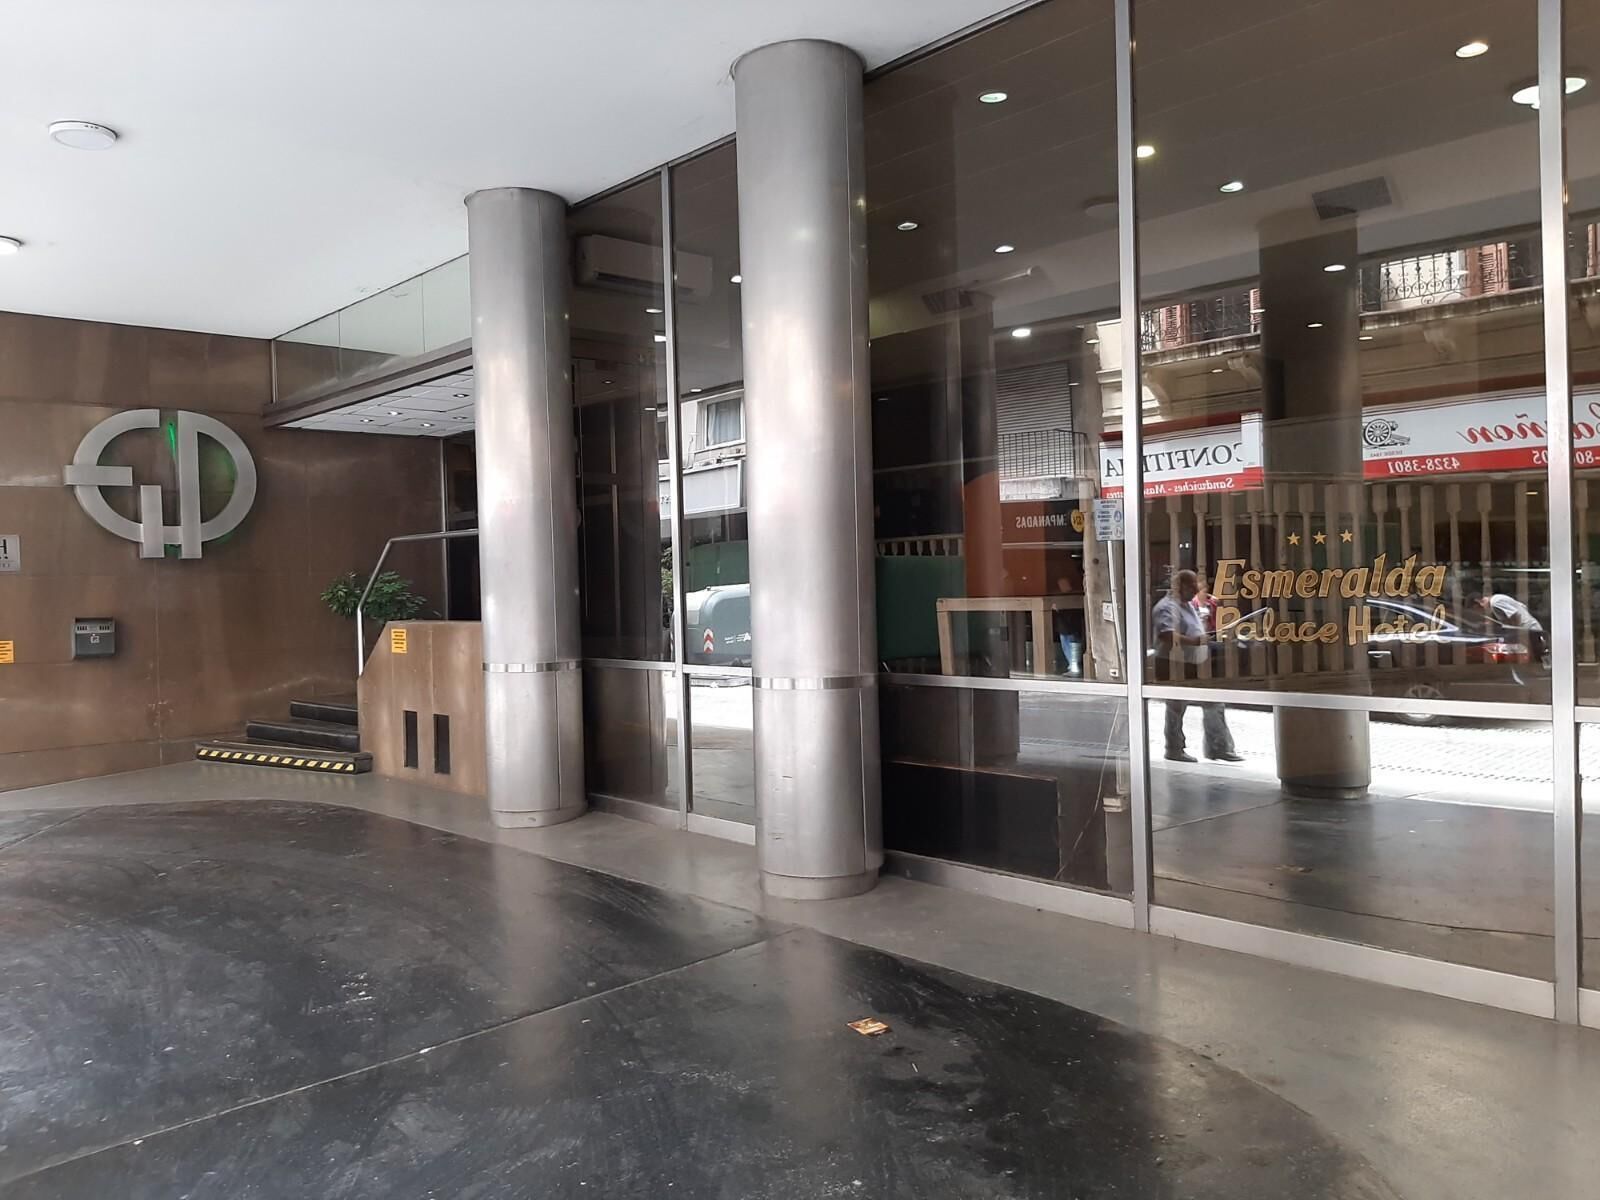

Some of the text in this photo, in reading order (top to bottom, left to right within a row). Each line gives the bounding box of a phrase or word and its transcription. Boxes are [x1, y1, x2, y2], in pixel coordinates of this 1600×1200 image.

[1212, 552, 1447, 600] Esmeralda
[1215, 603, 1453, 646] Palace Hotel
